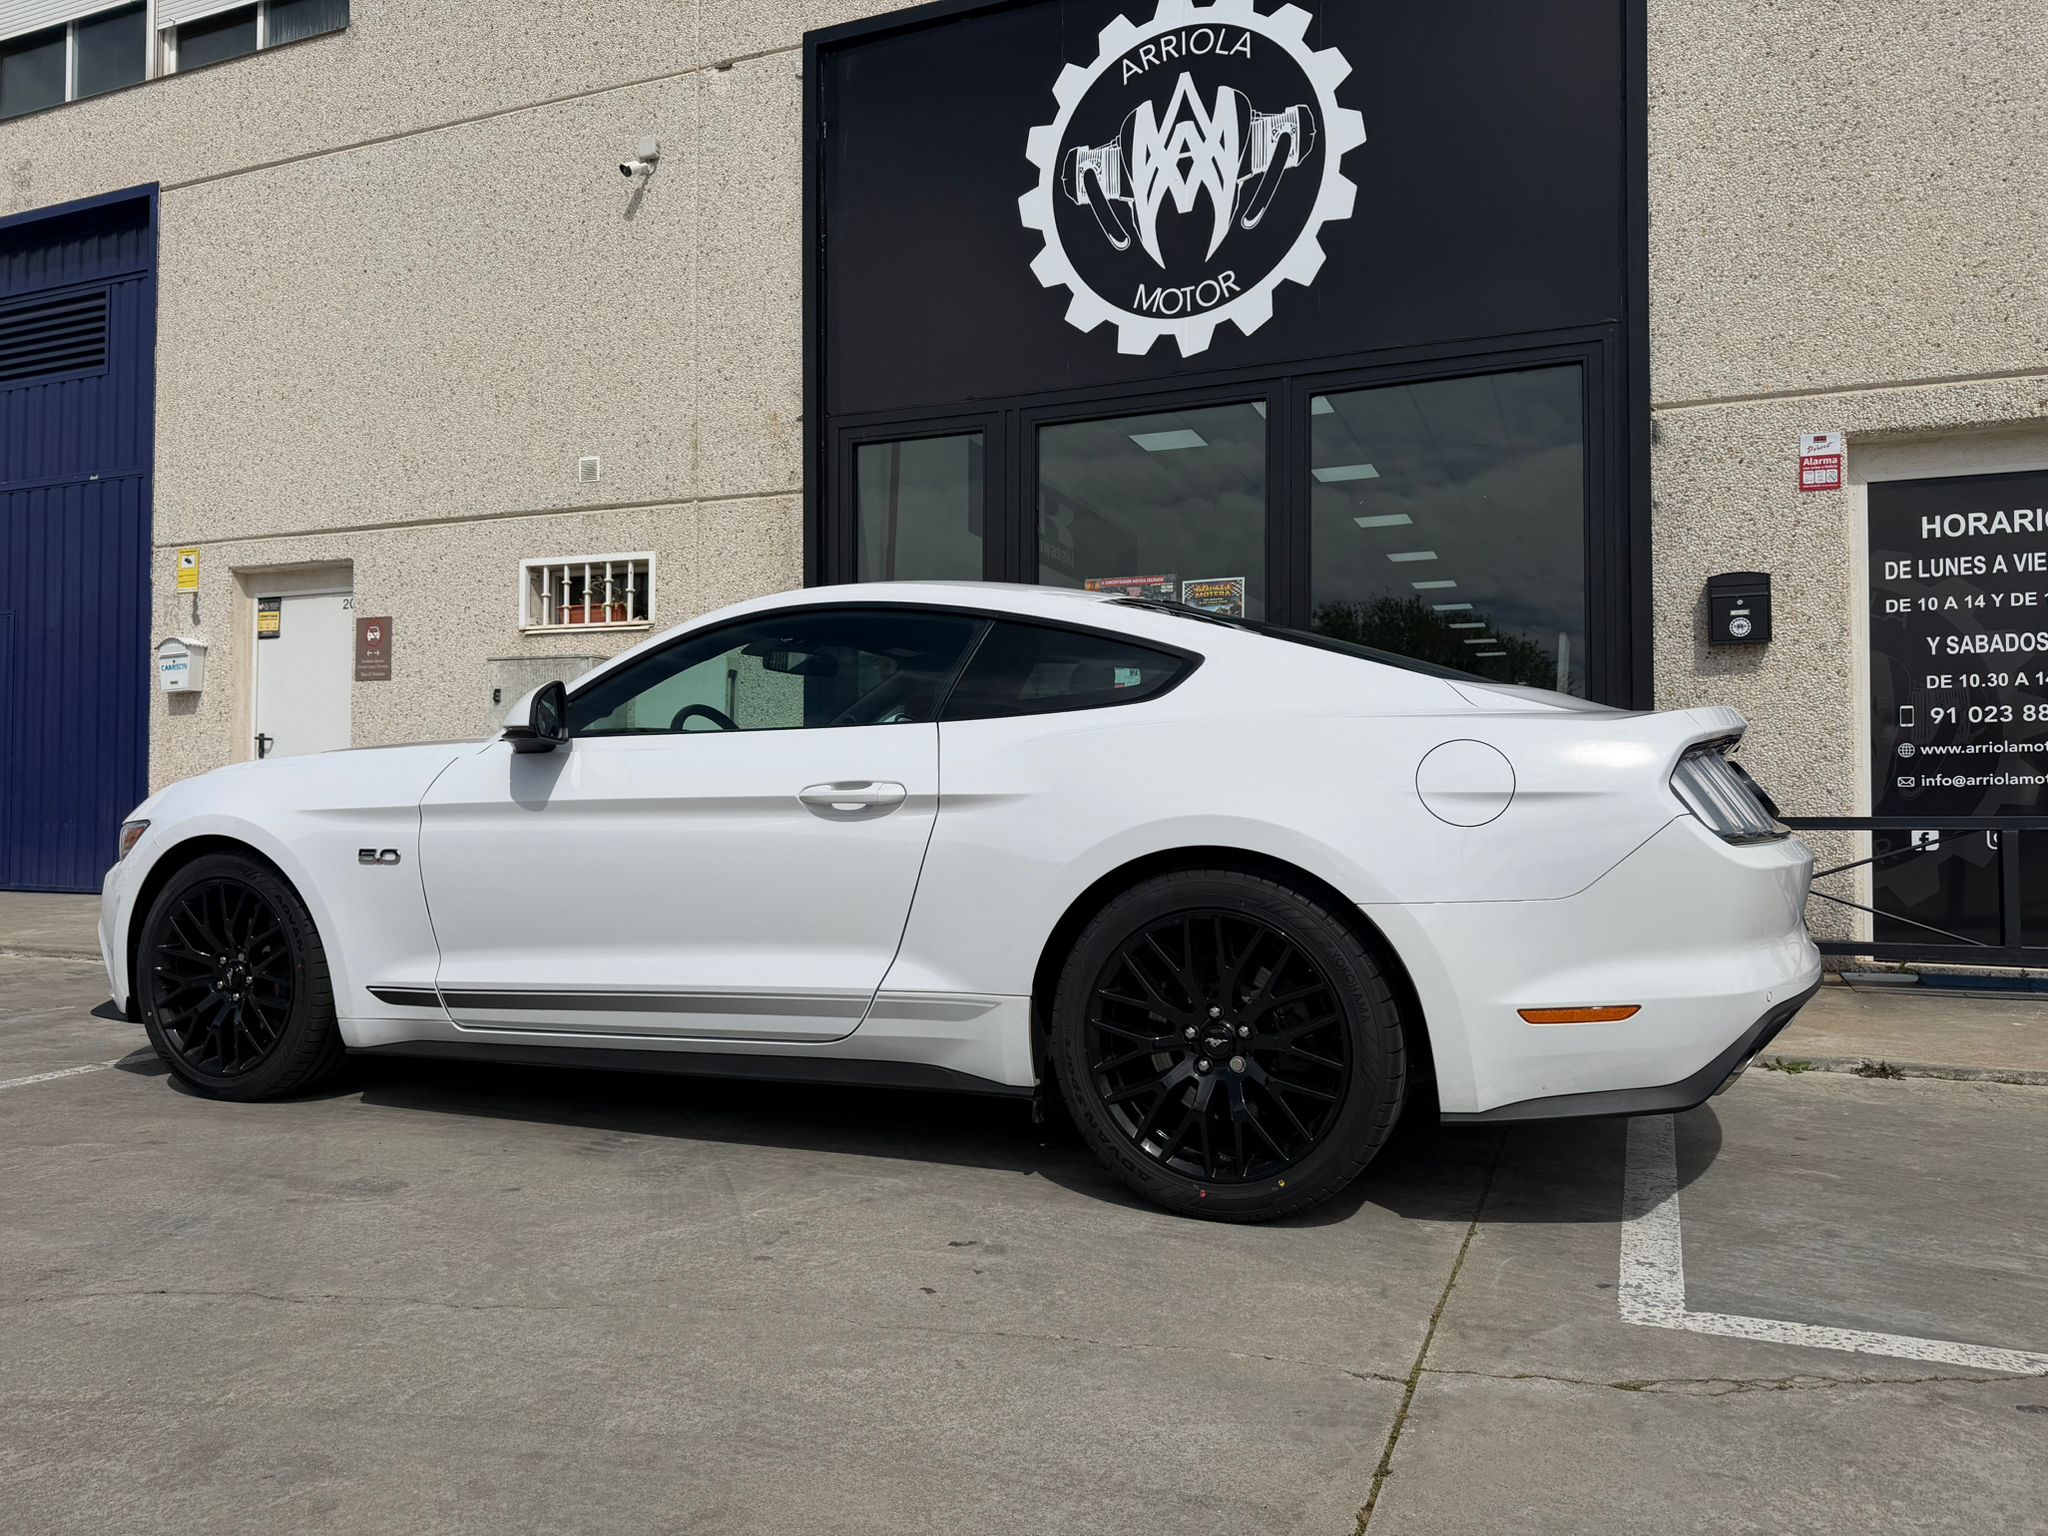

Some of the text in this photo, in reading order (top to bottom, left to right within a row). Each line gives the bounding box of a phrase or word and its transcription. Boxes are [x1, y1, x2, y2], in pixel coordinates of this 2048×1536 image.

[1121, 28, 1252, 85] ARRIOLA
[1133, 269, 1241, 315] MOTOR
[1803, 457, 1838, 466] Alarma
[1885, 560, 1912, 580] DE
[1918, 556, 1987, 578] LUNES
[1992, 554, 2008, 574] A
[1885, 599, 1912, 613] DE
[1917, 597, 1938, 611] 10
[1944, 596, 1959, 610] A
[1964, 594, 1986, 609] 14
[1990, 593, 2005, 607] Y
[2010, 592, 2038, 606] DE
[1926, 632, 2048, 655] Y SABADOS
[1926, 675, 1953, 689] DE
[1959, 673, 2009, 688] 10.30
[2014, 672, 2030, 686] A
[1930, 706, 1957, 724] 91
[1968, 705, 2014, 723] 023
[358, 848, 401, 866] 5.0
[275, 894, 304, 953] ADVAN
[1333, 950, 1371, 1023] YOKOHAMA
